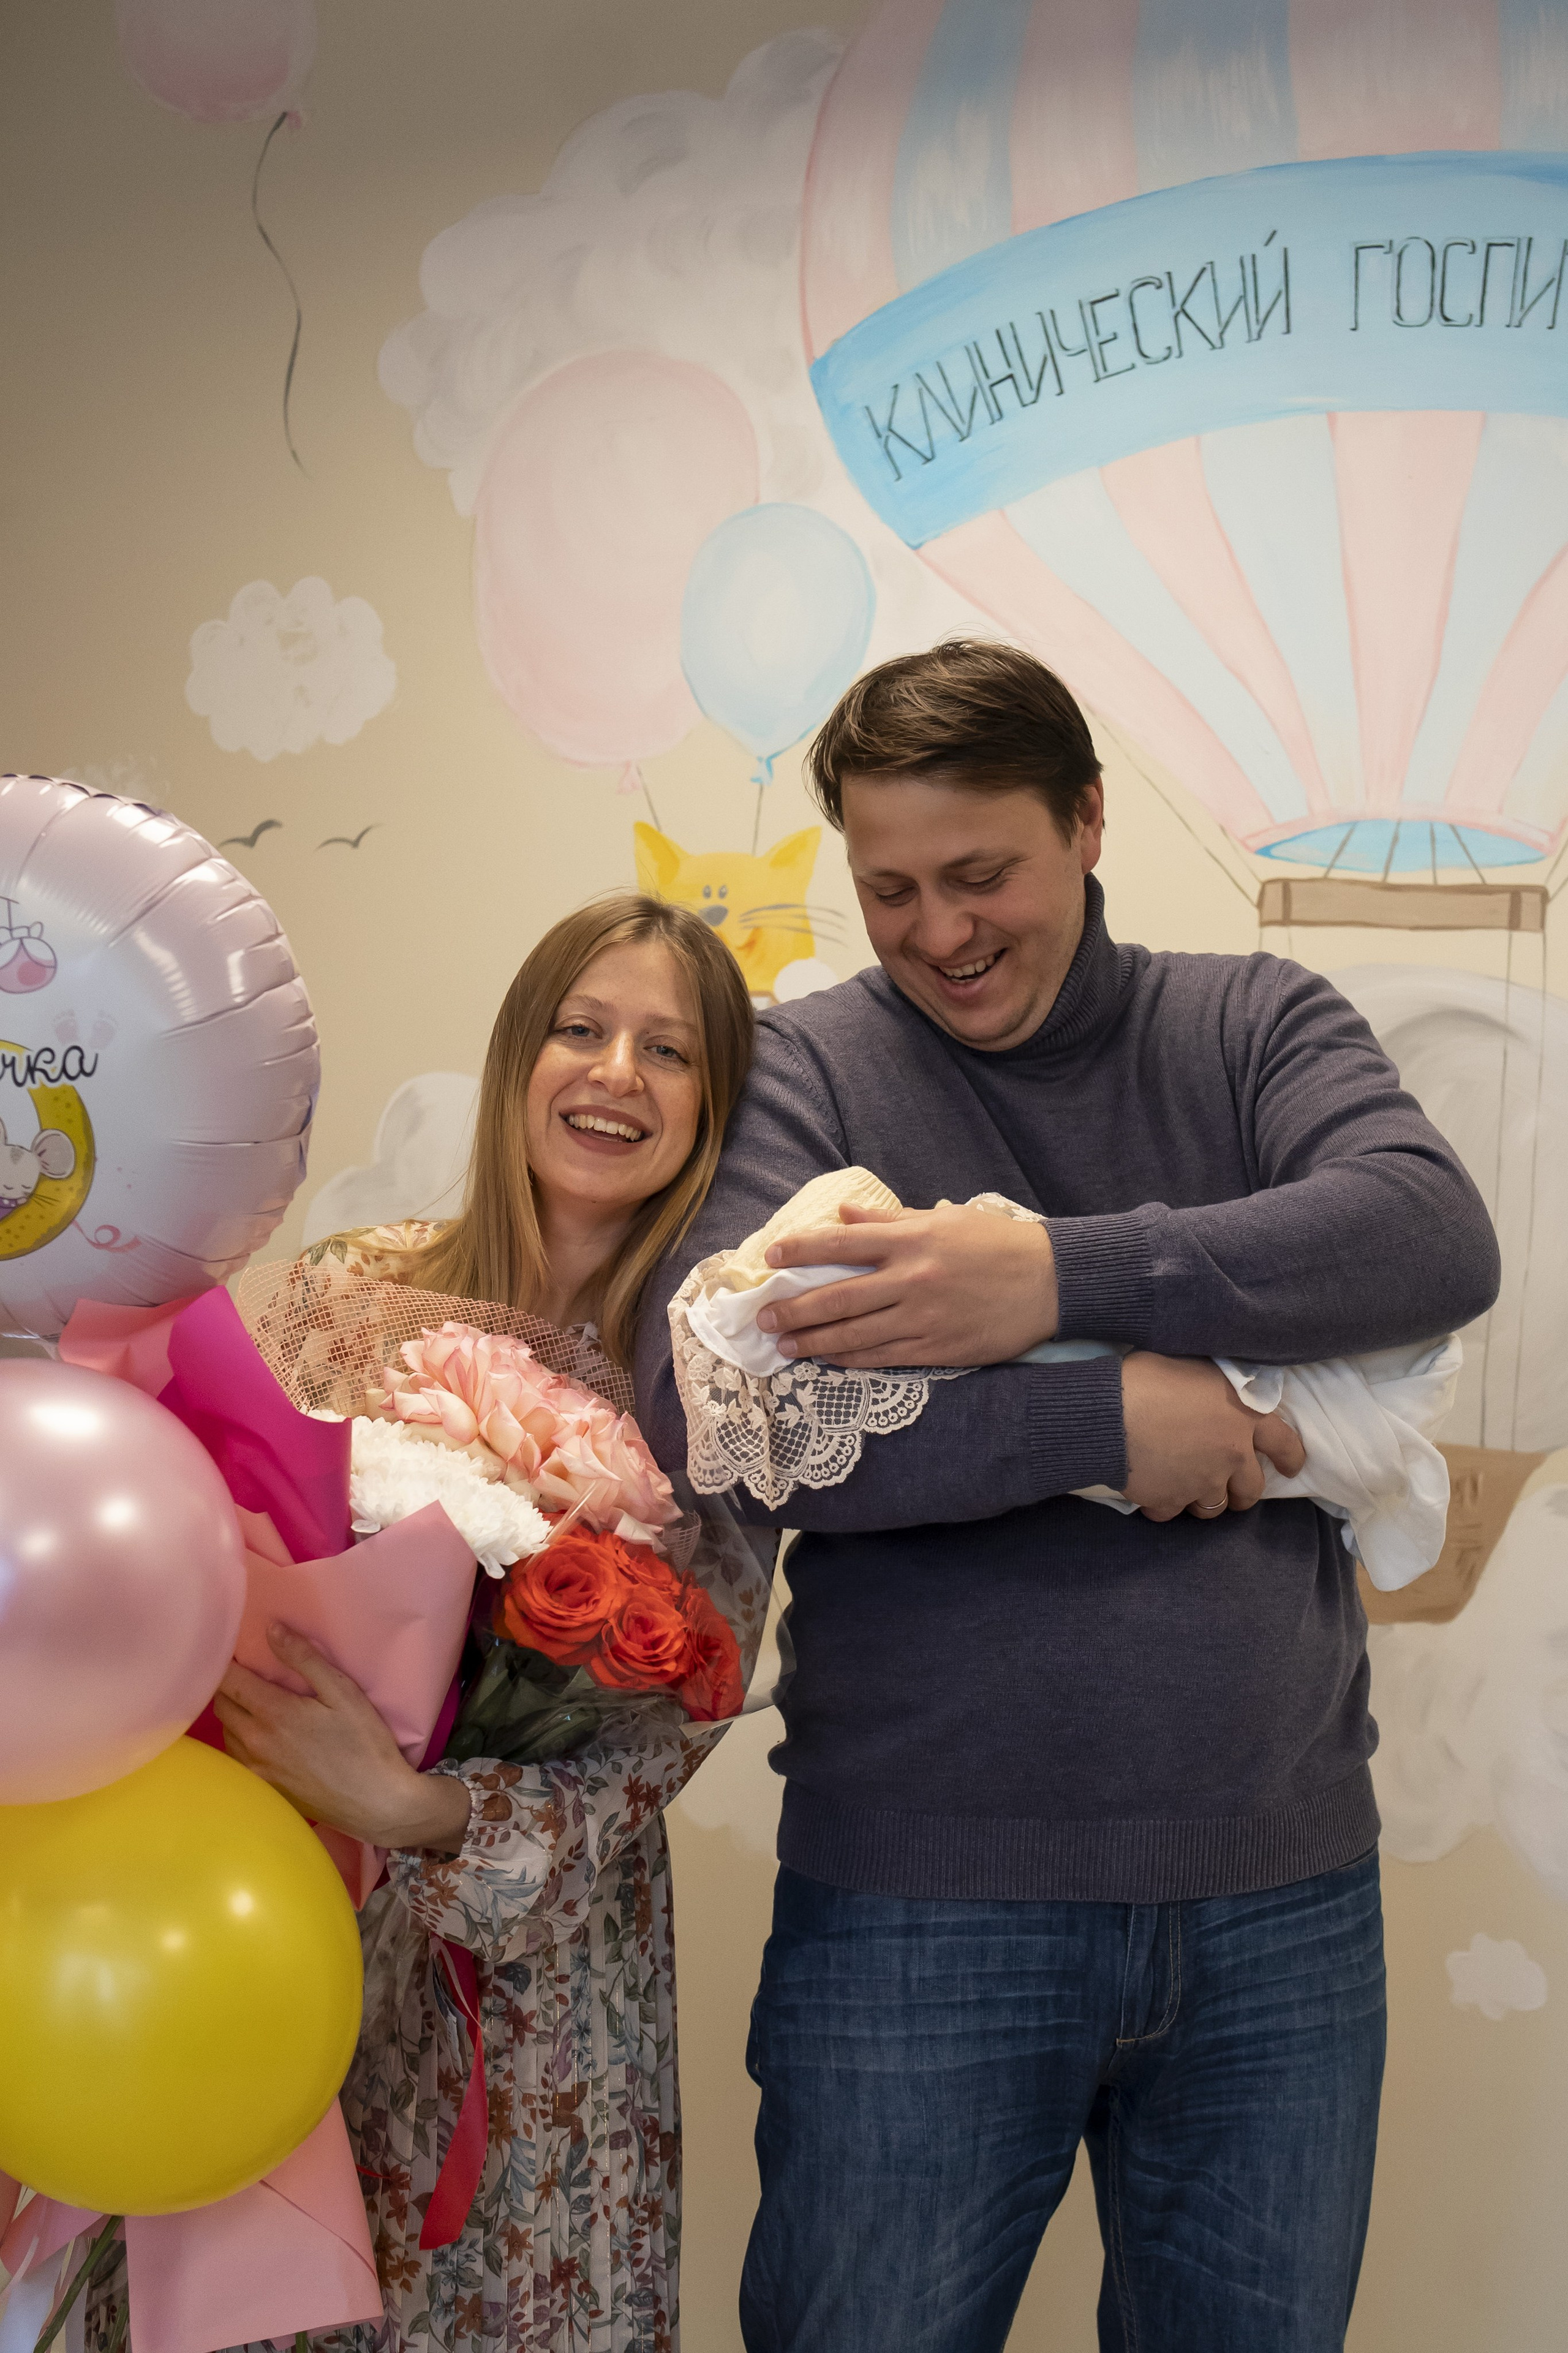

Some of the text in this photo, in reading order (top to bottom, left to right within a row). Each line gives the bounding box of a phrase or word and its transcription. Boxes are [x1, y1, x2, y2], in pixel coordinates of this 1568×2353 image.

[864, 229, 1568, 482] КЛИНИЧЕСКИЙ ГОСПИ
[0, 1045, 99, 1087] чка
